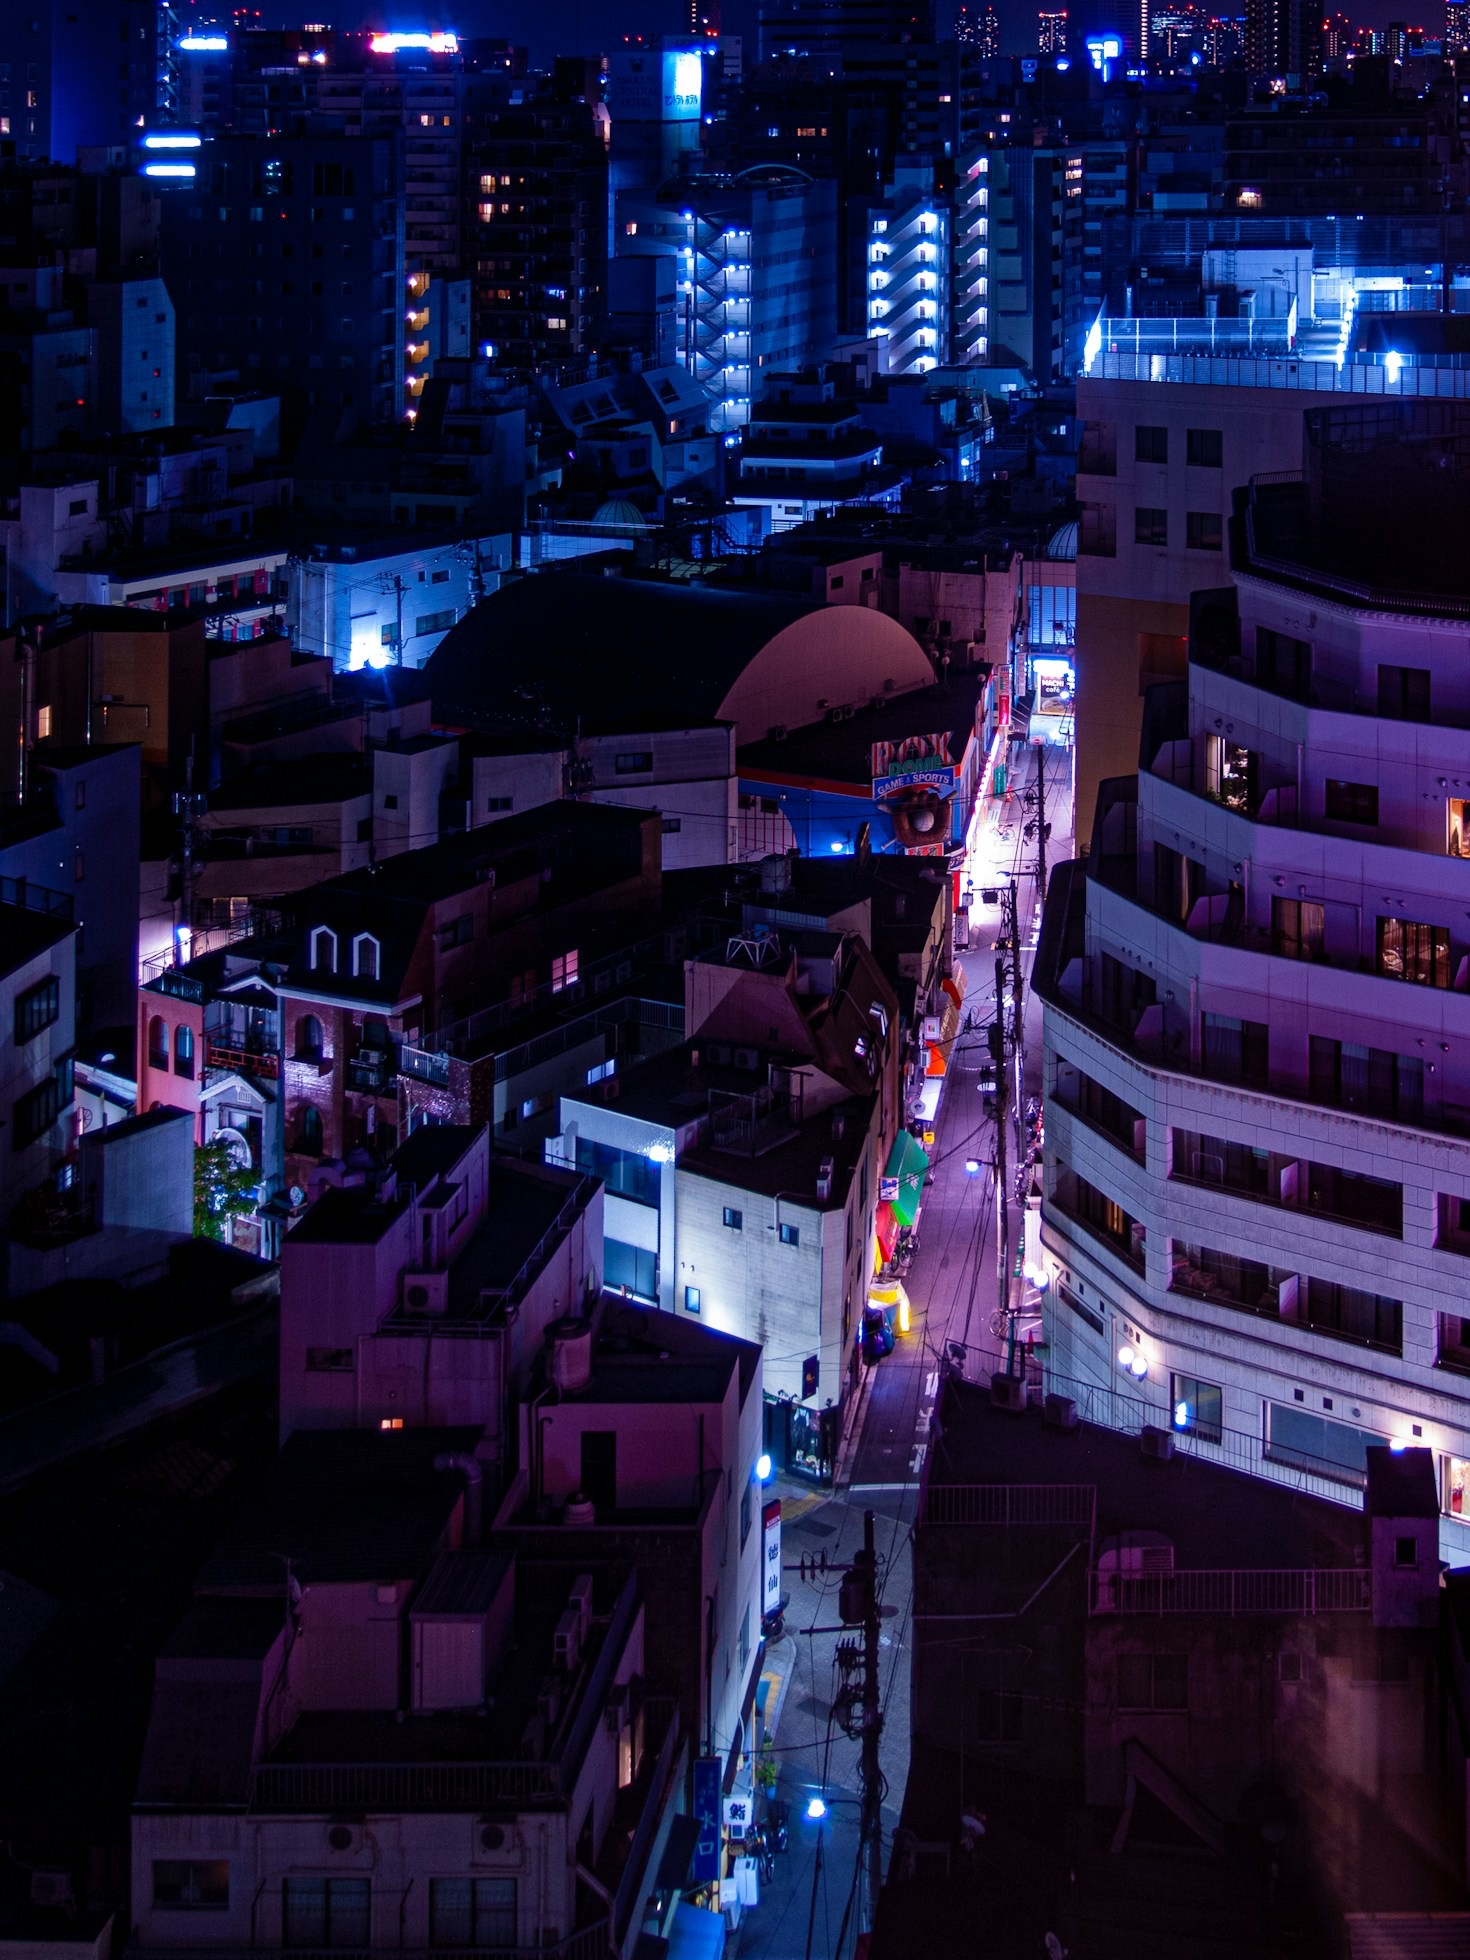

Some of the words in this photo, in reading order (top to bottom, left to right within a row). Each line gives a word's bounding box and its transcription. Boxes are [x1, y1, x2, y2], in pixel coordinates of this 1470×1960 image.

[1042, 679, 1064, 687] MACHI
[872, 731, 956, 776] ROX
[889, 755, 943, 778] DOME
[877, 777, 905, 795] GAME
[912, 773, 950, 784] SPORTS
[729, 1802, 746, 1820] 鮨
[698, 1810, 717, 1856] 水口
